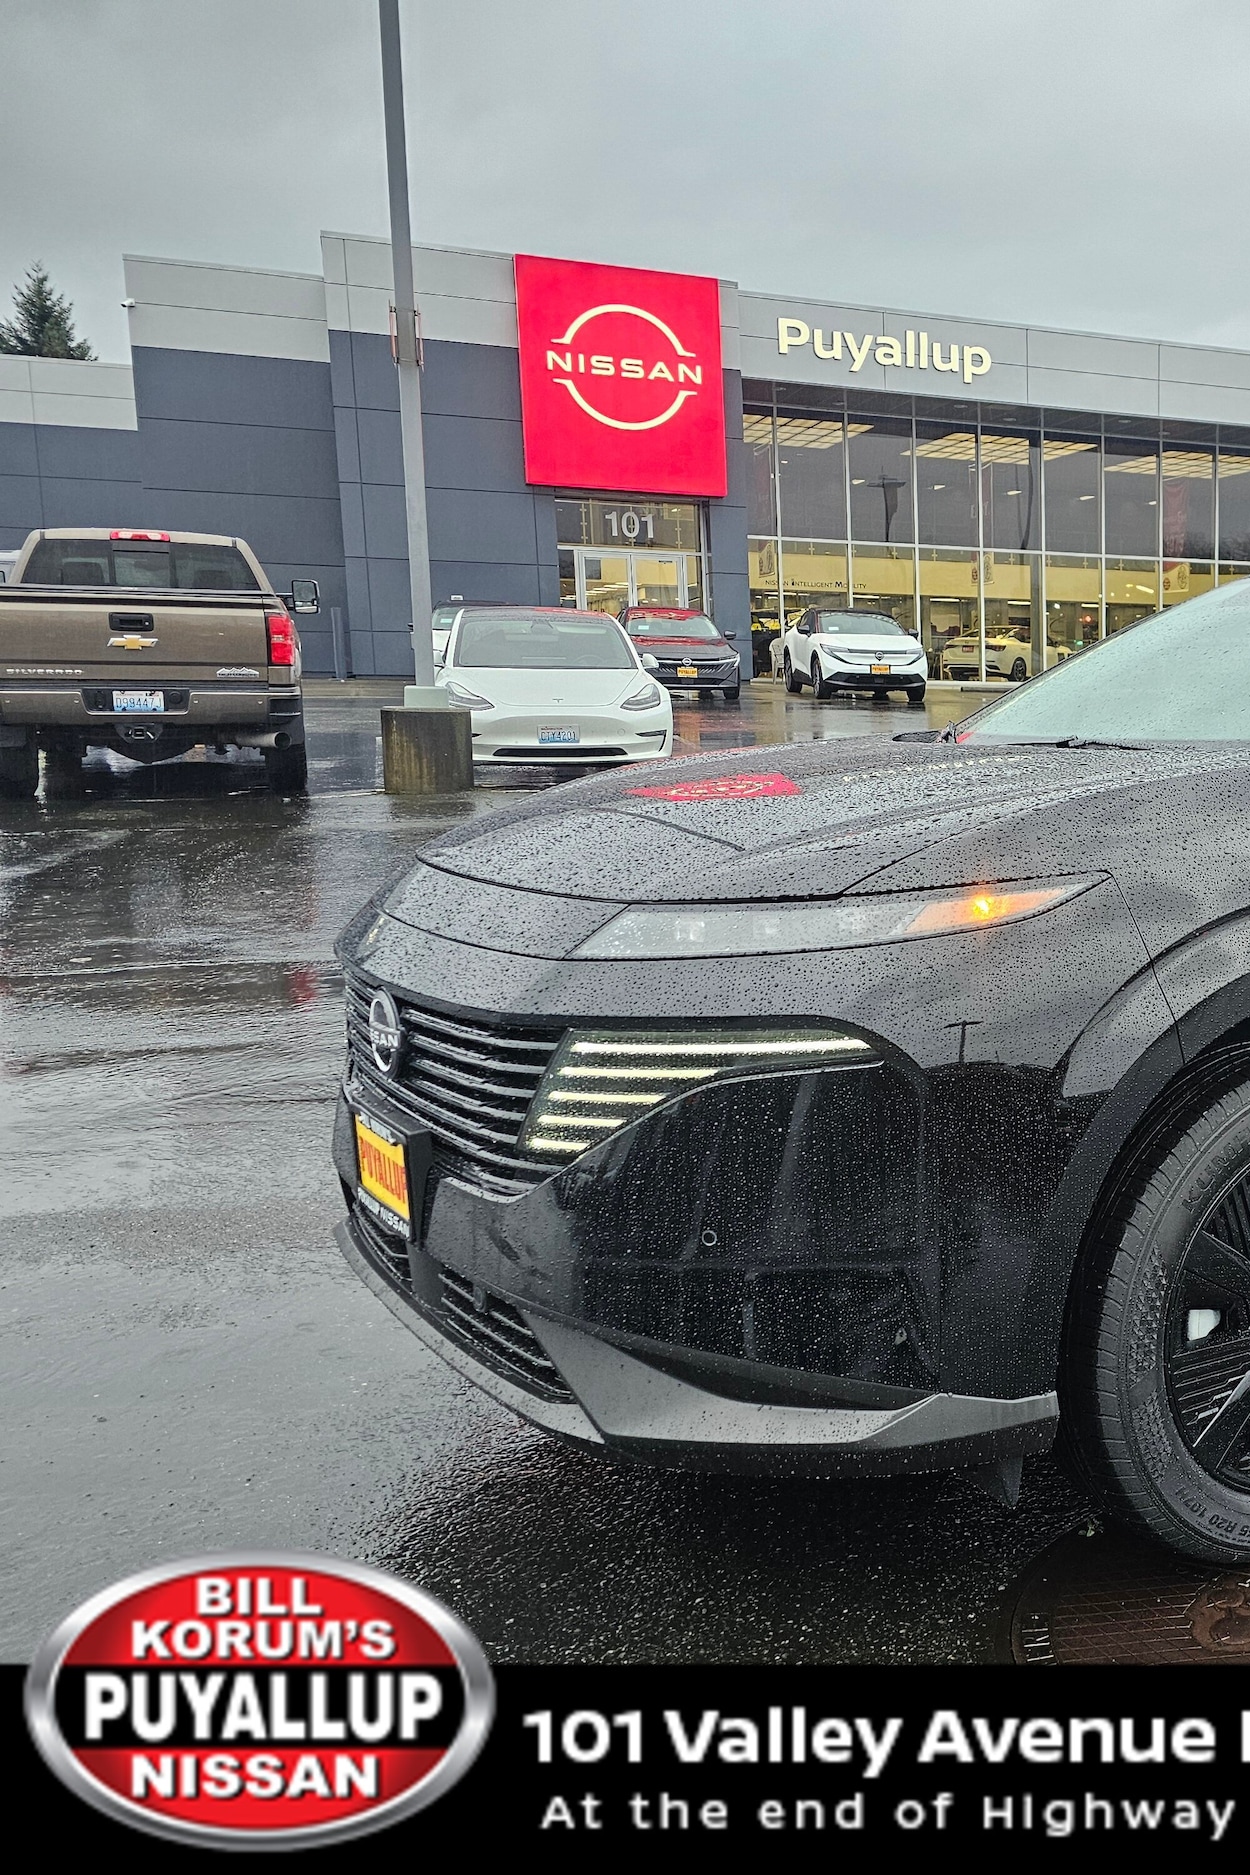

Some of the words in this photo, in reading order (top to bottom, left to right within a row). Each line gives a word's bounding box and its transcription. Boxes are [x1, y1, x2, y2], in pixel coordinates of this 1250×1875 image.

[777, 317, 993, 384] Puyallup
[546, 350, 703, 385] NISSAN
[604, 511, 654, 539] 101
[834, 581, 867, 590] MOLITY
[5, 668, 84, 676] SILVERADO
[1208, 1513, 1238, 1534] R20
